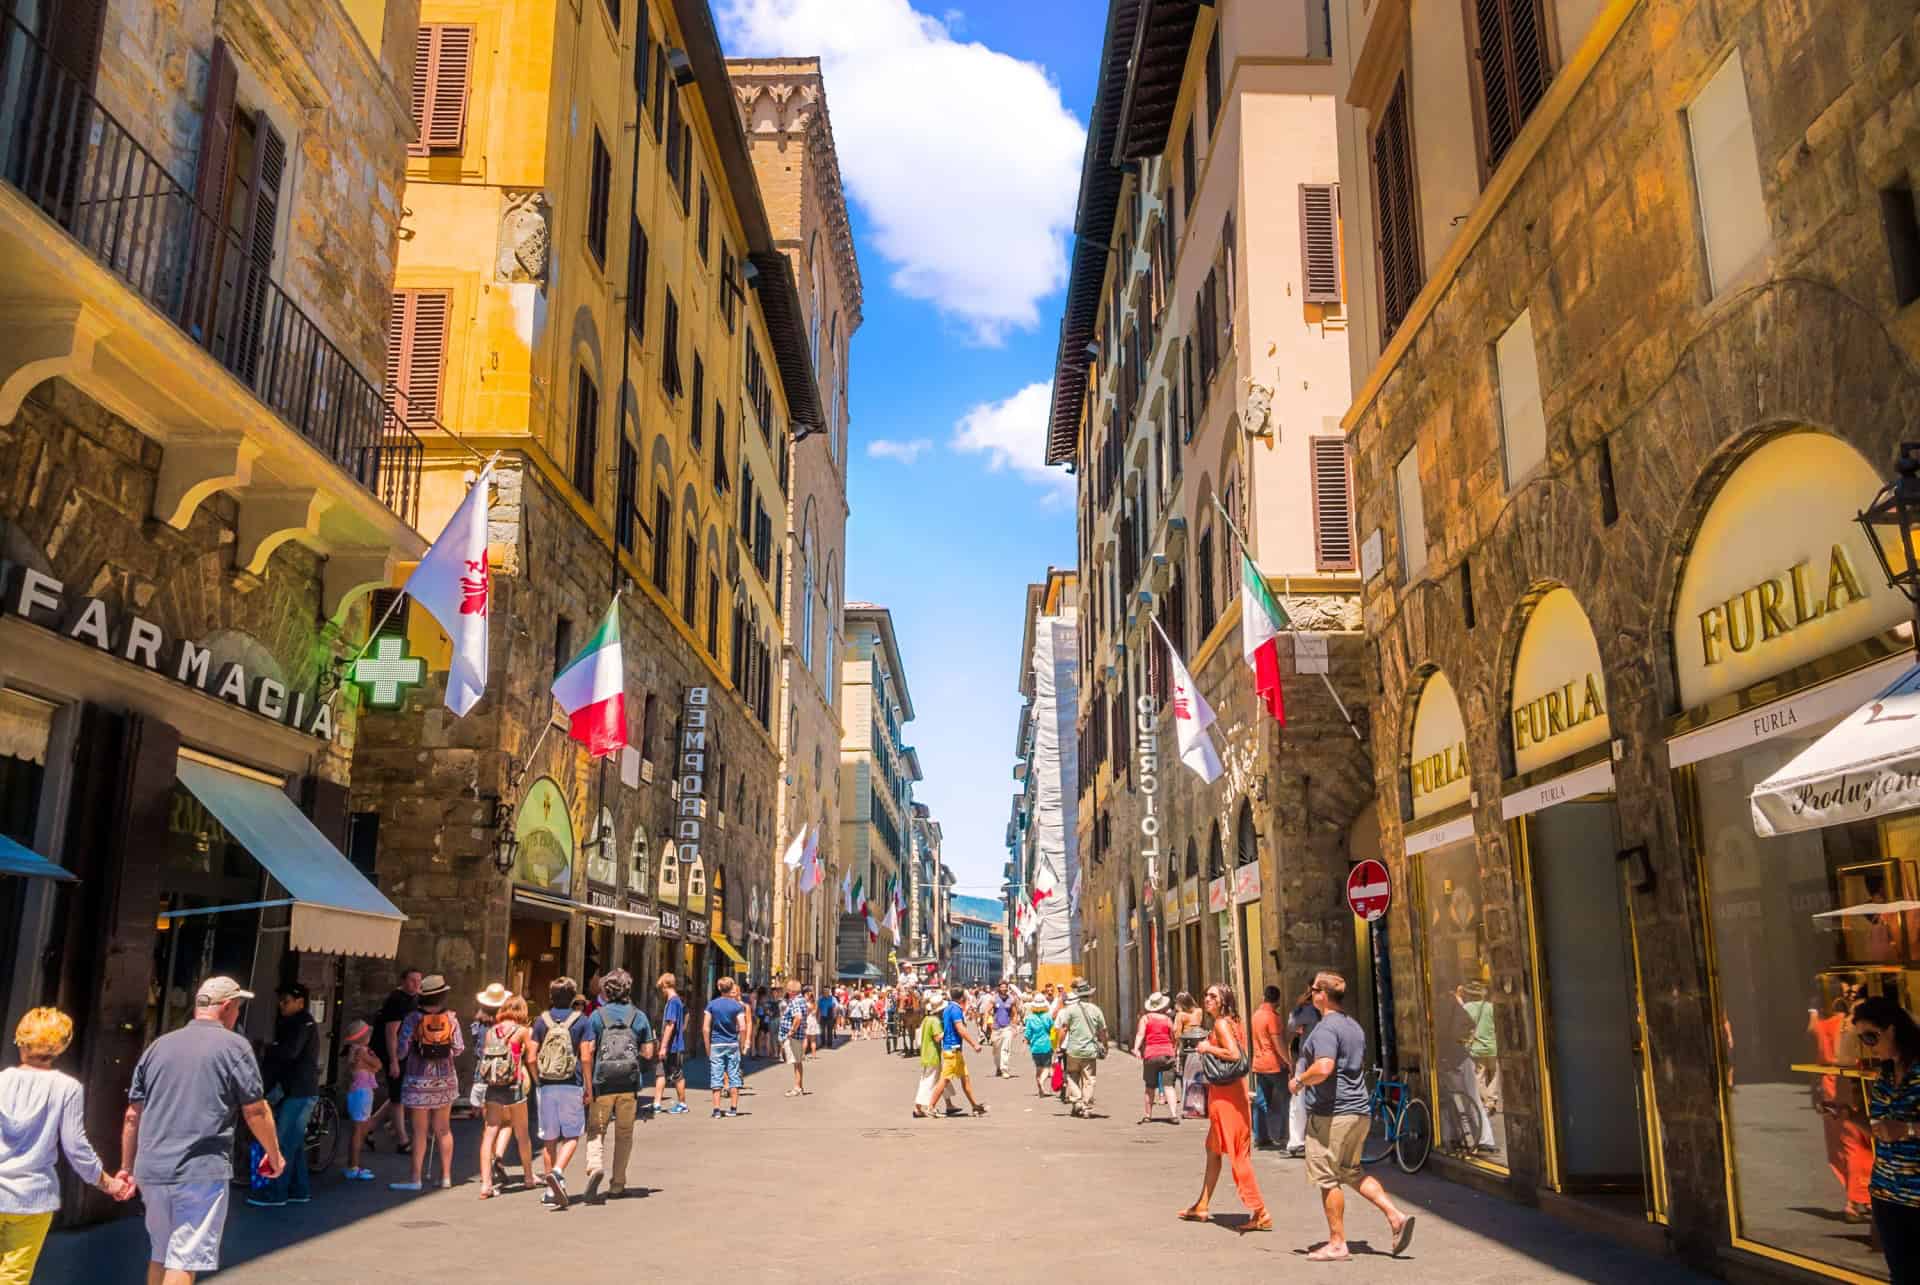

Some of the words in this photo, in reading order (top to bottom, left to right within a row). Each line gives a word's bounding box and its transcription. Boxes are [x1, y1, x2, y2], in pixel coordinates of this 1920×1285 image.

[1698, 544, 1868, 665] FURLA
[18, 568, 333, 740] FARMACIA
[1514, 672, 1605, 750] FURLA
[1753, 706, 1798, 736] FURLA
[1412, 741, 1471, 797] FURLA
